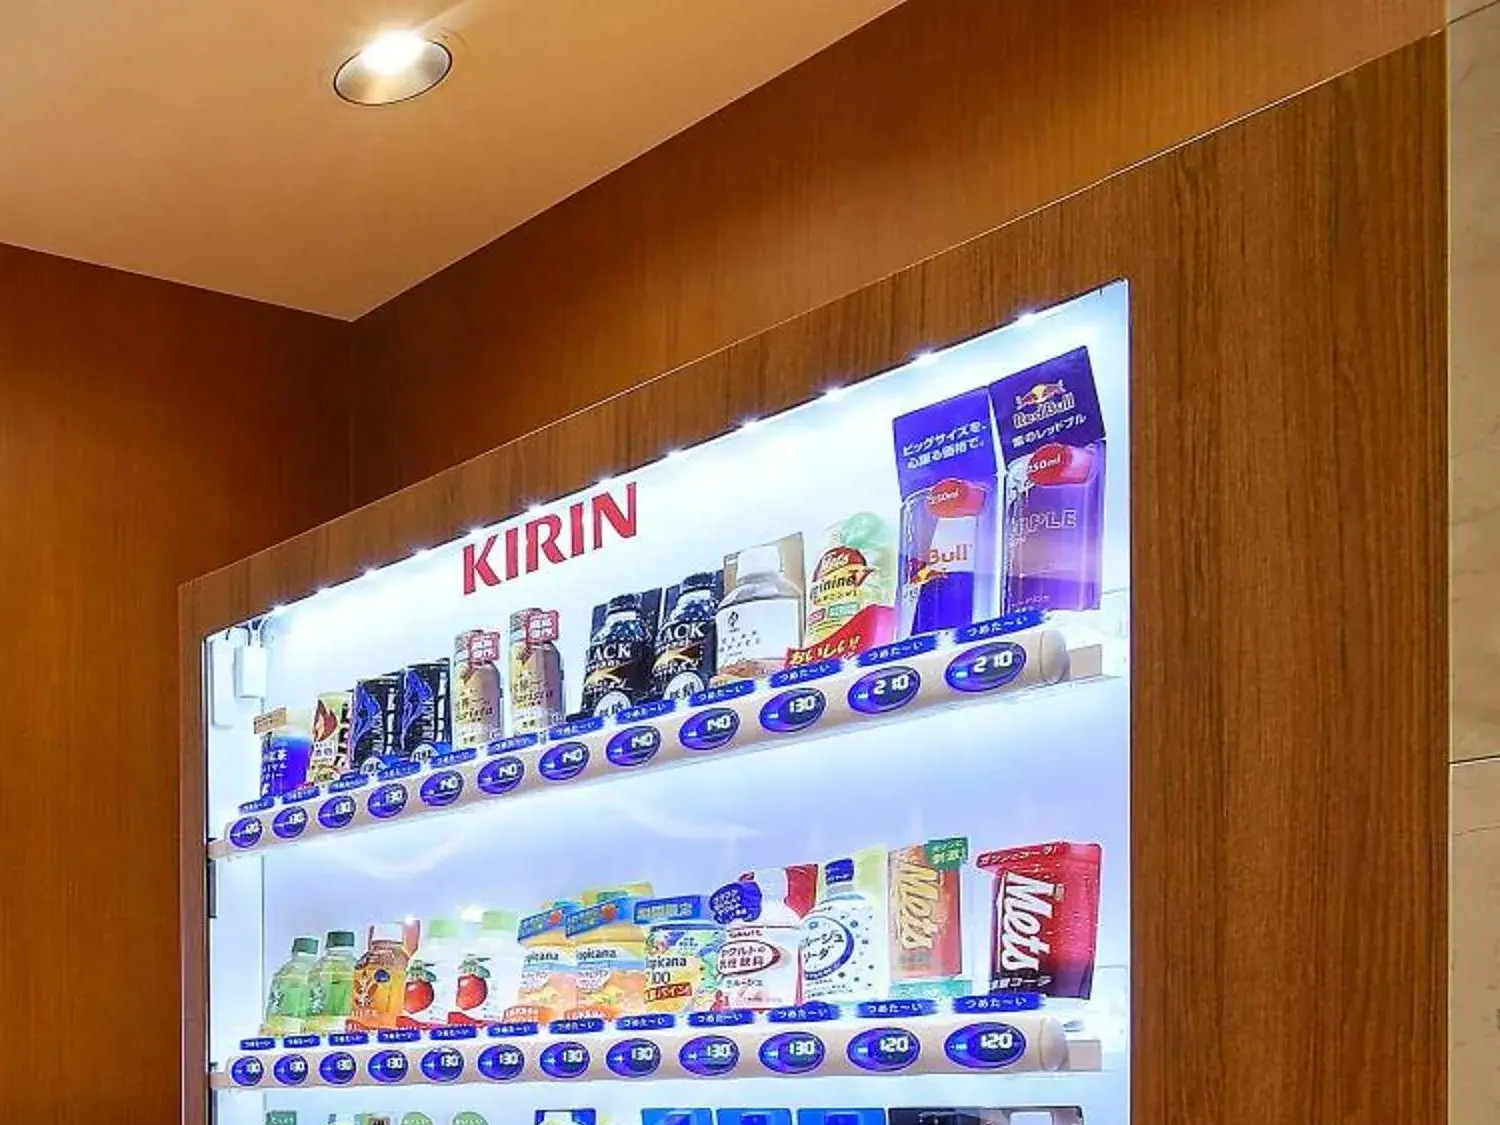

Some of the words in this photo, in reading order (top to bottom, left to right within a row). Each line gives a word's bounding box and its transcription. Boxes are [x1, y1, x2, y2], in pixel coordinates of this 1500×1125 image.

[463, 482, 638, 595] KIRIN
[973, 650, 1012, 674] 210
[790, 695, 817, 713] 130
[1001, 872, 1054, 971] Mets
[788, 1040, 815, 1055] 130
[880, 1035, 909, 1052] 120
[981, 1030, 1014, 1049] 120
[498, 1052, 520, 1065] 130
[563, 1049, 585, 1062] 130
[630, 1047, 653, 1060] 130
[706, 1044, 730, 1058] 130
[440, 1055, 459, 1067] 130
